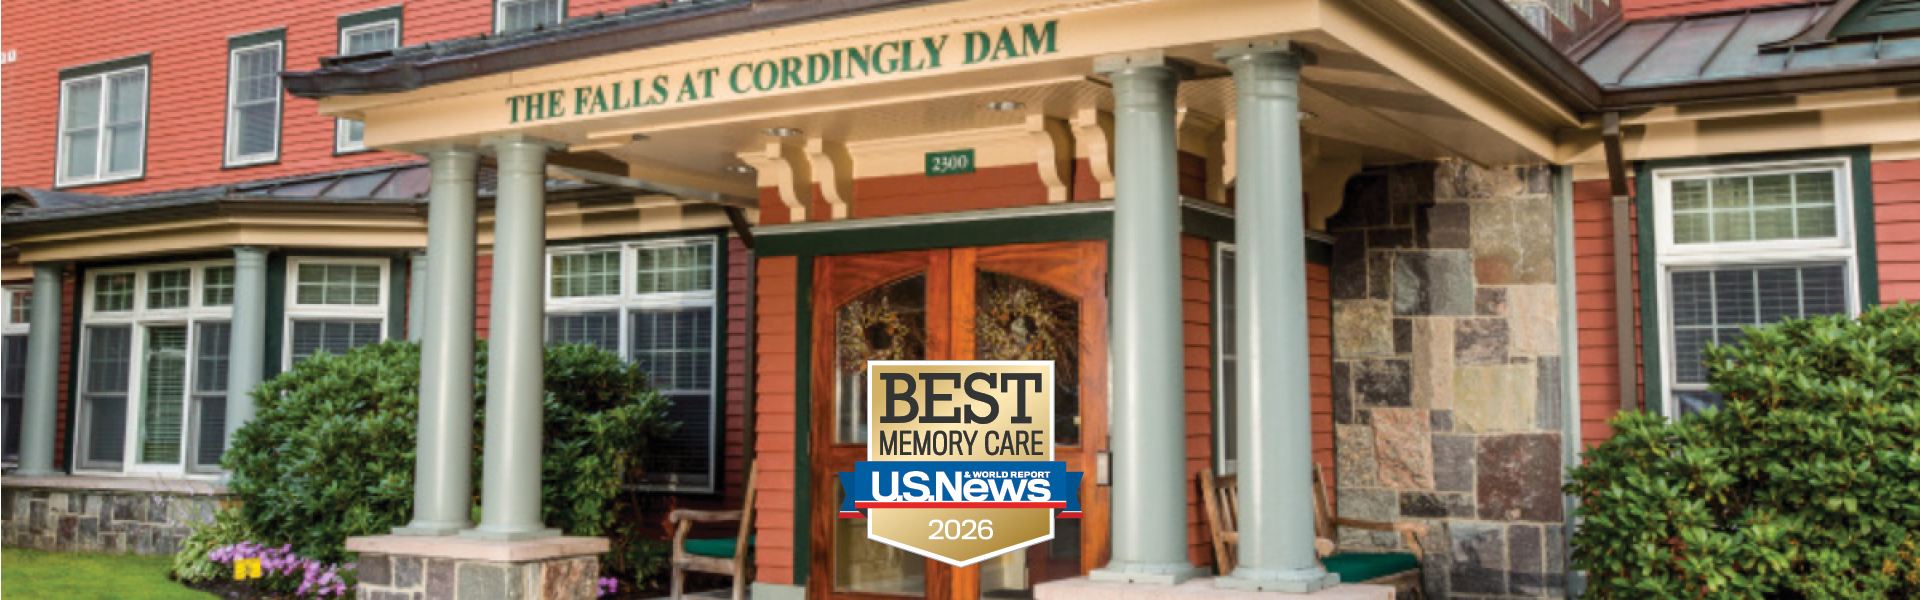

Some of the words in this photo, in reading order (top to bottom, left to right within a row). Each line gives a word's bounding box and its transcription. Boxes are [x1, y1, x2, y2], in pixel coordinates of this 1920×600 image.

[506, 88, 565, 124] THE
[574, 77, 669, 116] FALLS
[676, 67, 719, 103] AT
[729, 34, 949, 94] CORDINGLY
[962, 20, 1058, 65] DAM
[931, 154, 969, 173] 2300
